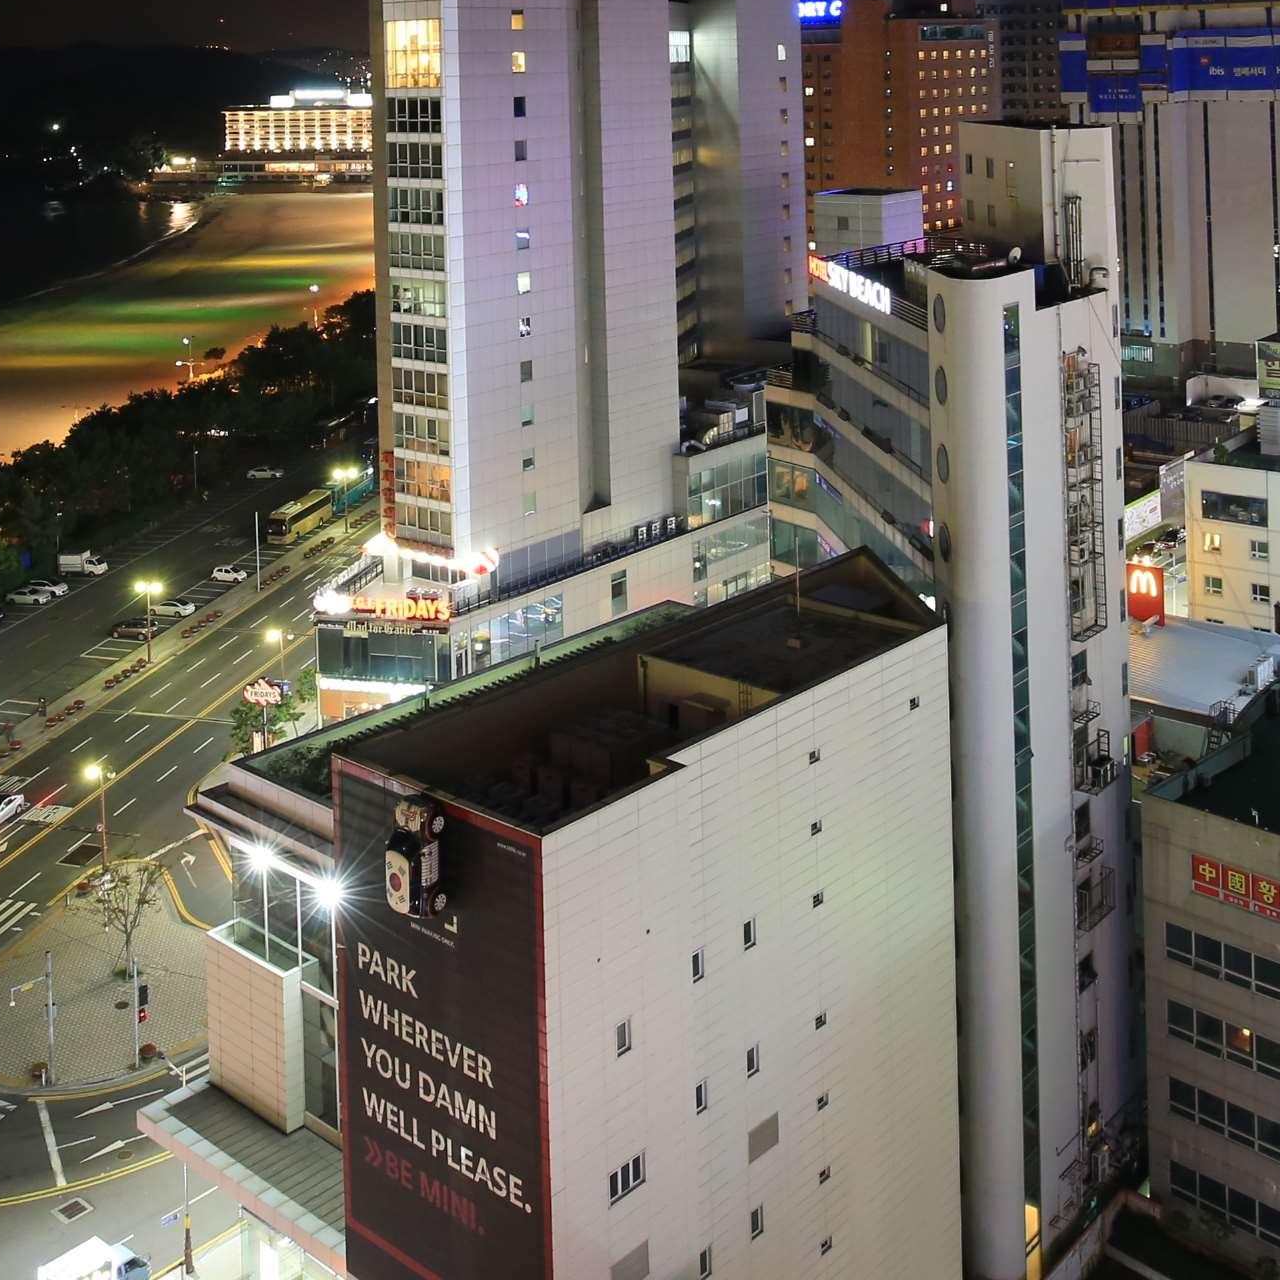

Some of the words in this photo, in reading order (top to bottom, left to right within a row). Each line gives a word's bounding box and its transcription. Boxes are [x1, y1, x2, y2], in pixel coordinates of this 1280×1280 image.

[1209, 66, 1225, 76] ibis
[829, 261, 849, 293] SKY
[849, 272, 892, 315] BEACH
[357, 942, 418, 999] PARK
[358, 988, 495, 1089] WHEREVER
[360, 1037, 412, 1090] YOU
[418, 1070, 497, 1141] DAMN
[362, 1087, 426, 1151] WELL
[431, 1128, 534, 1214] PLEASE.
[385, 1154, 414, 1192] BE
[420, 1168, 487, 1235] MINI.
